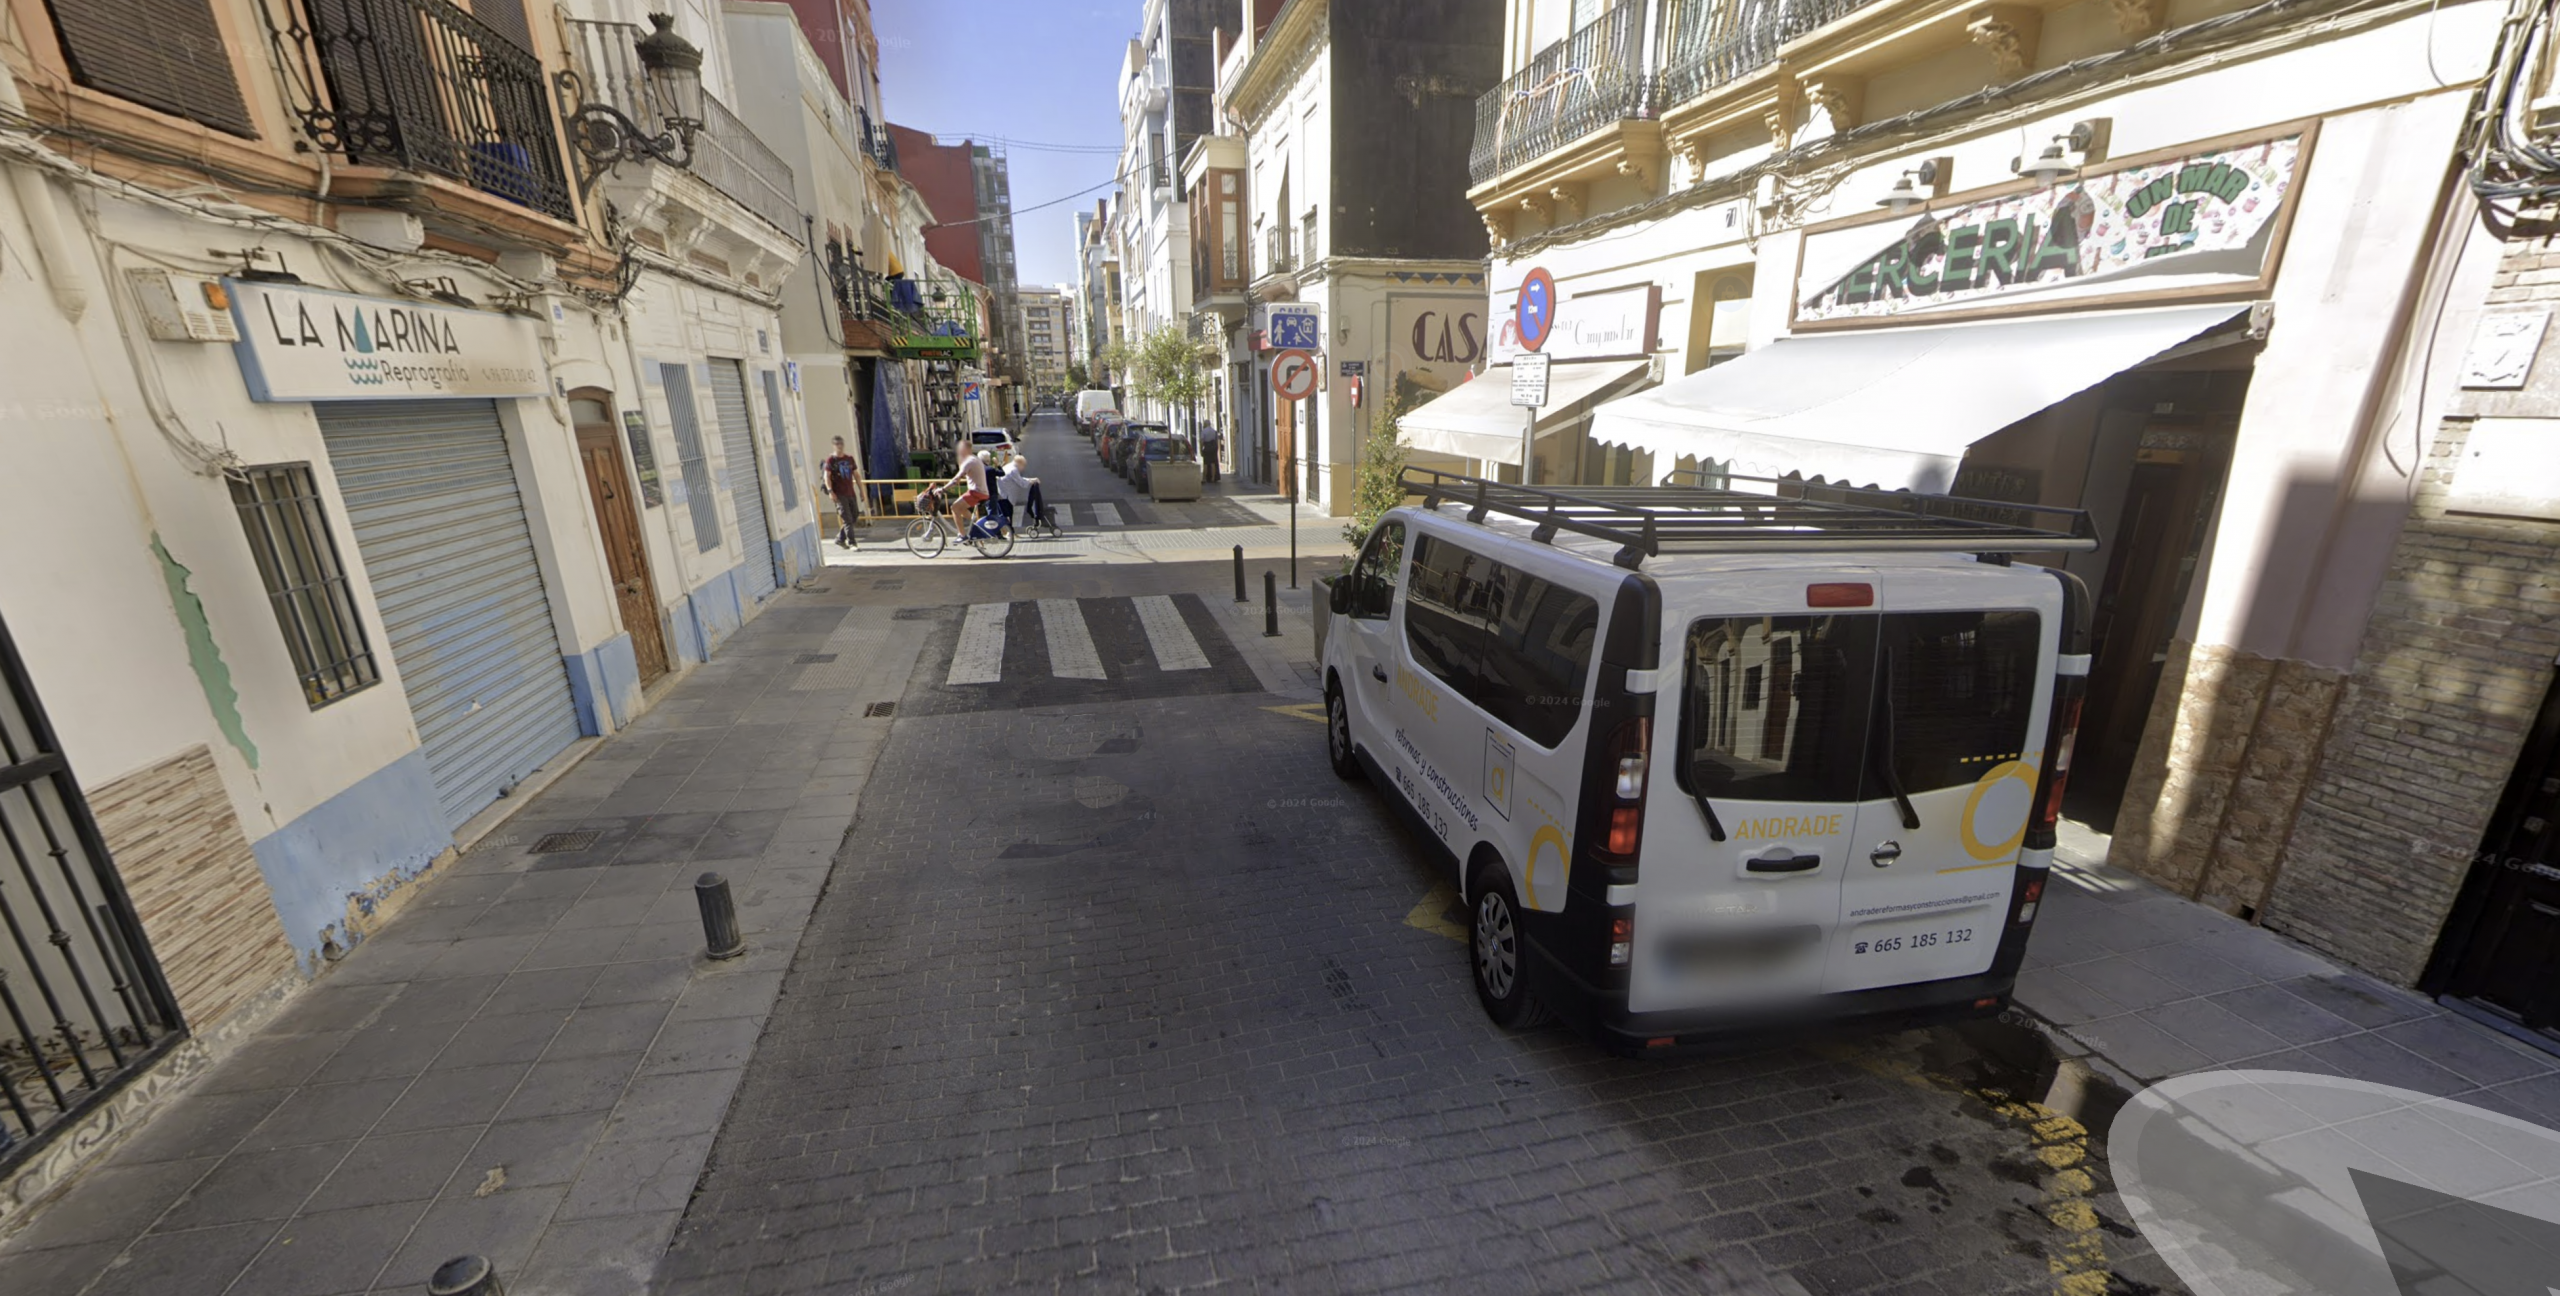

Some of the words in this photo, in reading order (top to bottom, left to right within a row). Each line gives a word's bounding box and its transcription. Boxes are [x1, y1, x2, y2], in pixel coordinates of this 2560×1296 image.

[2126, 171, 2173, 218] UN
[2177, 162, 2250, 205] MAR
[2160, 199, 2198, 237] DE
[1838, 206, 2079, 305] ERCERIA
[263, 293, 323, 347] LA
[334, 303, 460, 354] MARINA
[1397, 664, 1439, 723] ANDRADE
[1395, 728, 1421, 764] reformas
[1420, 759, 1426, 776] y
[1426, 765, 1478, 832] construcciones
[1403, 775, 1414, 800] 665
[1418, 792, 1430, 820] 185
[1434, 812, 1447, 842] 132
[1734, 814, 1843, 840] ANDRADE
[1850, 891, 2000, 917] andradereformasyconstrucciones@gmail.com
[1874, 937, 1902, 953] 665
[1910, 932, 1938, 949] 185
[1945, 928, 1972, 944] 132
